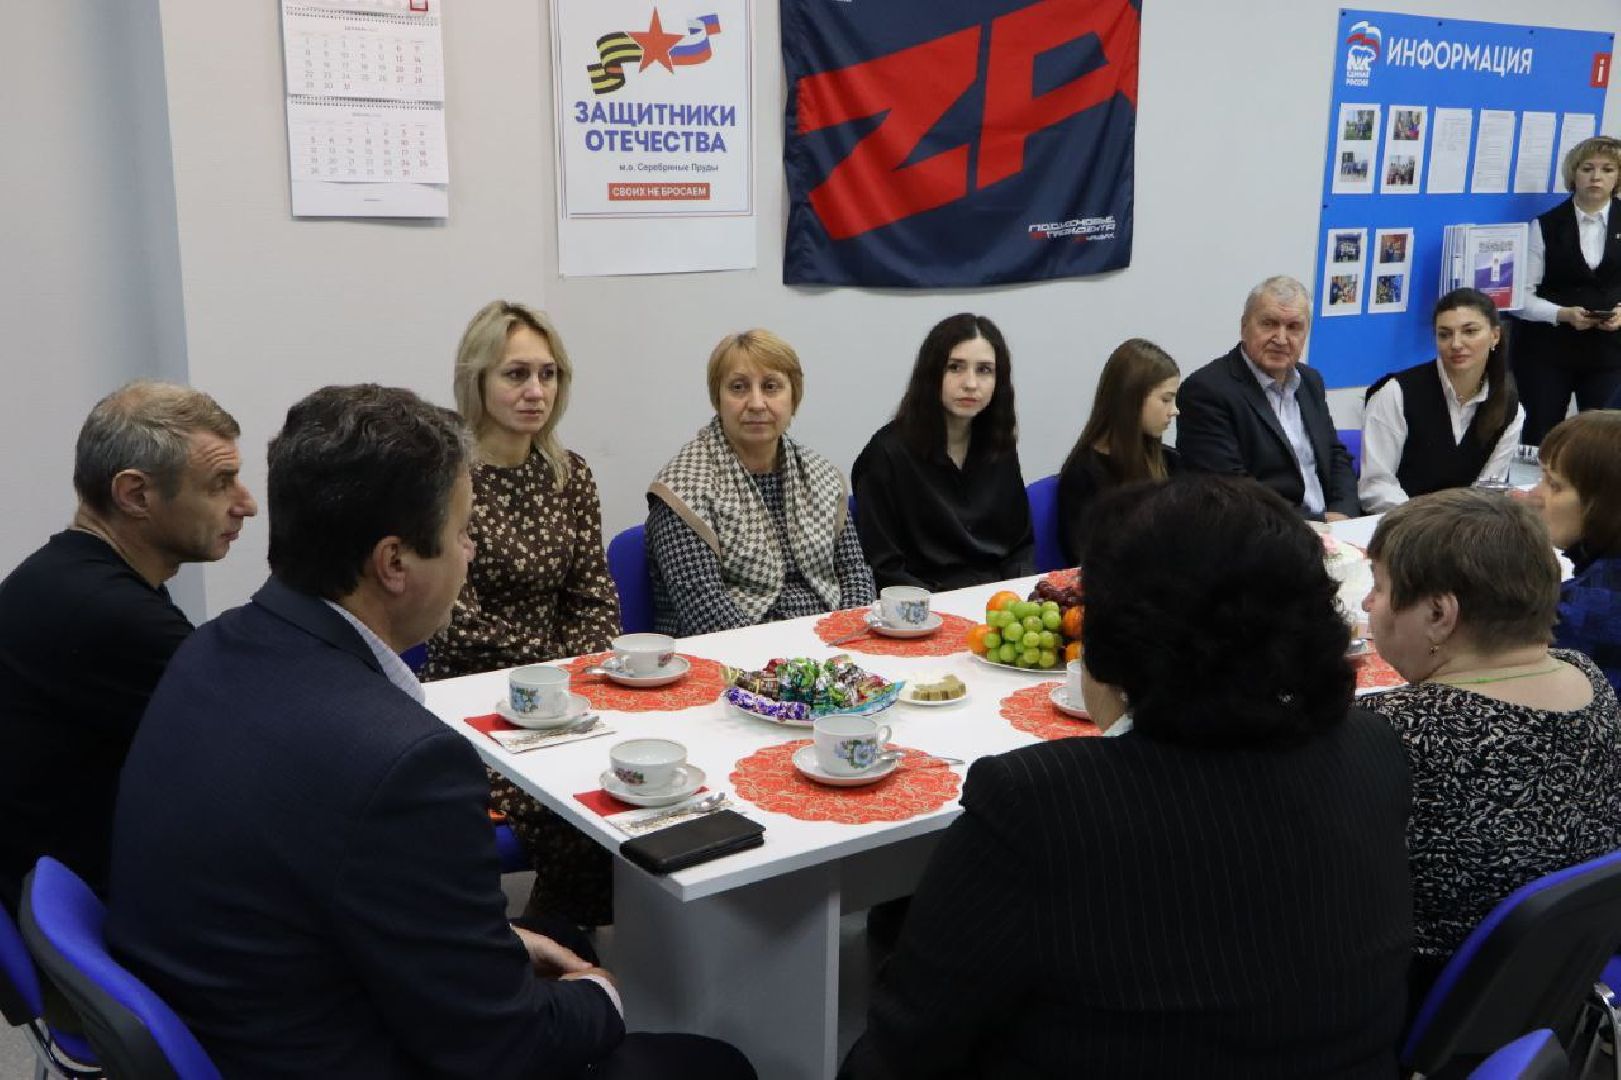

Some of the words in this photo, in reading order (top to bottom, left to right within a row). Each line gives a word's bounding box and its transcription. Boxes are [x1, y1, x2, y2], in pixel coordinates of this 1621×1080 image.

[1386, 36, 1533, 78] ИНФОРМАЦИЯ
[575, 101, 735, 126] ЗАЩИТНИКИ
[585, 130, 726, 152] ОТЕЧЕСТВА
[637, 162, 688, 173] Серебряные
[691, 163, 719, 173] Пруды
[612, 186, 646, 197] СВОИХ
[647, 187, 660, 197] НЕ
[661, 187, 706, 197] БРОСАЕМ
